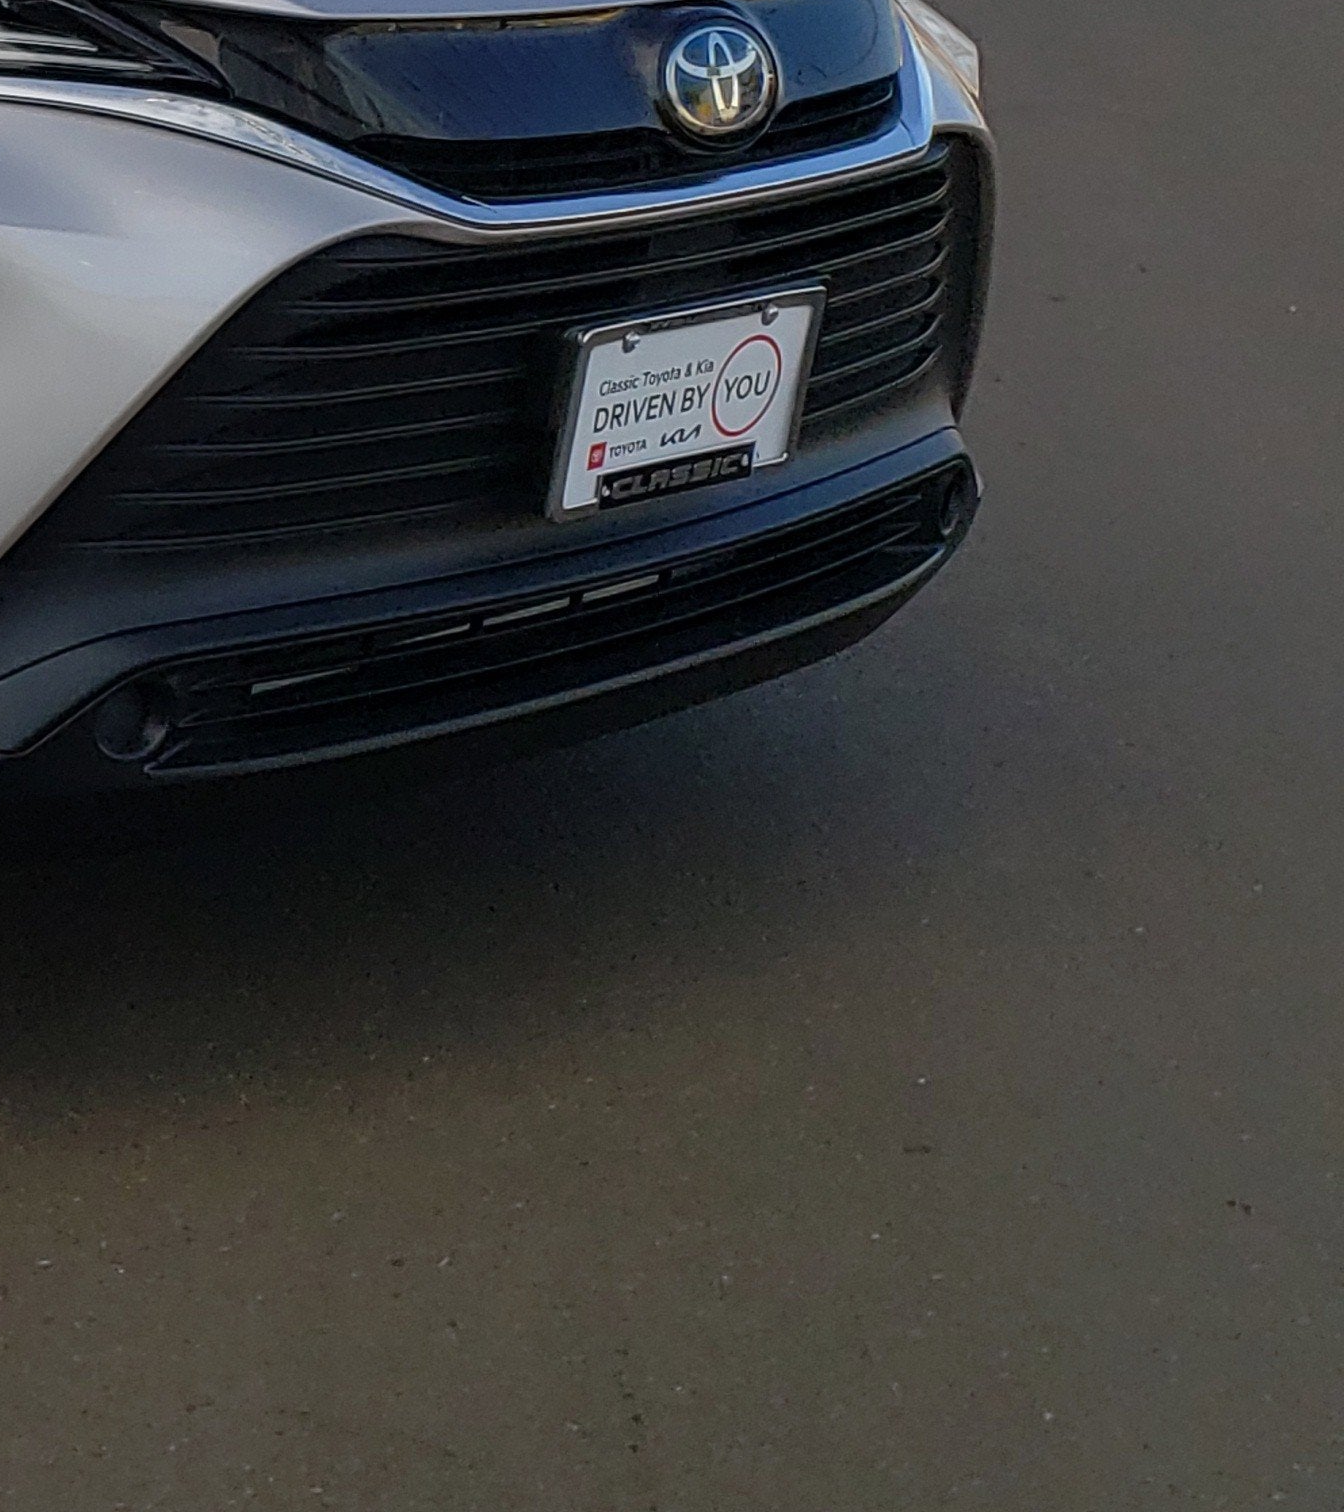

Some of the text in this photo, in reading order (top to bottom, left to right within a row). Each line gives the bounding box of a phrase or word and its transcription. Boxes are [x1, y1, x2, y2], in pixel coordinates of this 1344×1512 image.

[599, 358, 714, 397] Classic Toyota & Kia
[593, 370, 770, 434] DRIVEN BY YOU
[610, 439, 647, 458] TOYOTA
[613, 453, 743, 500] CLASSIC
